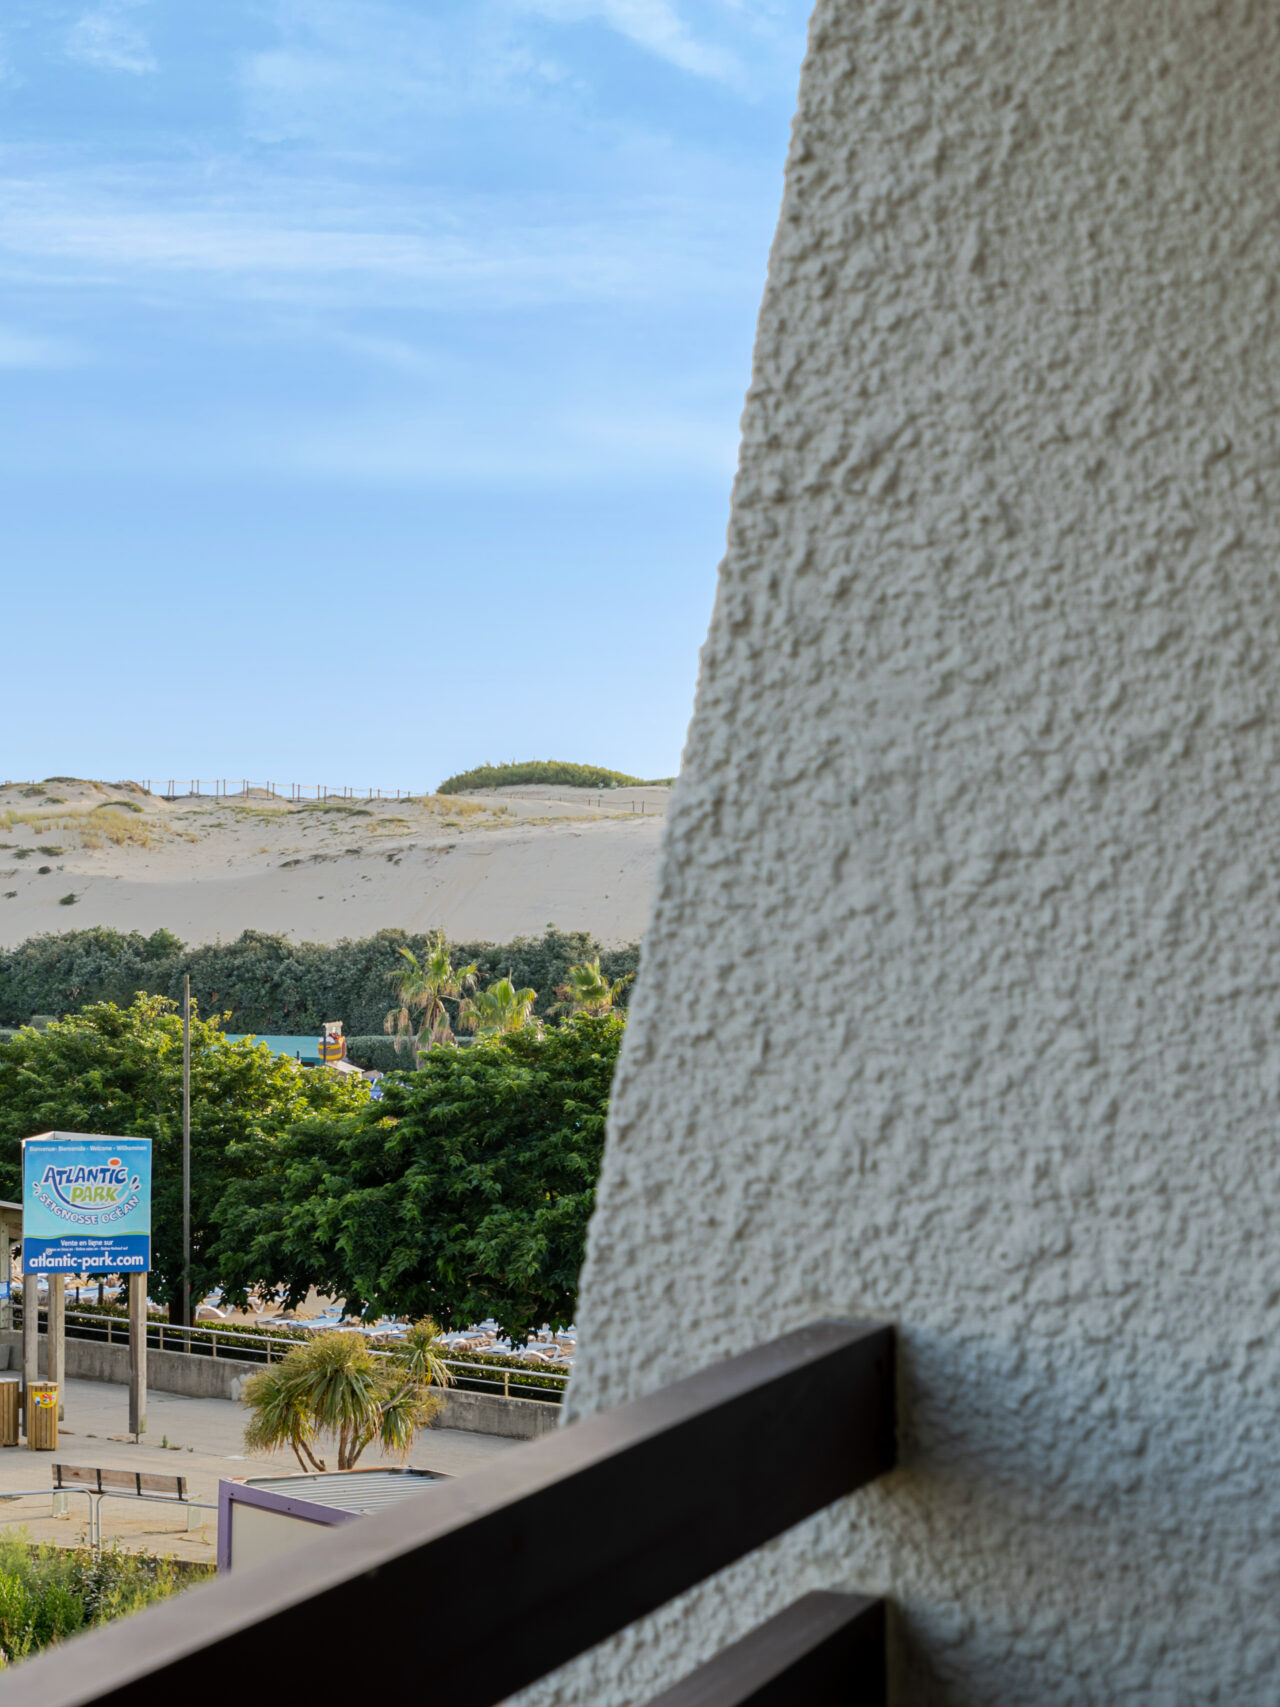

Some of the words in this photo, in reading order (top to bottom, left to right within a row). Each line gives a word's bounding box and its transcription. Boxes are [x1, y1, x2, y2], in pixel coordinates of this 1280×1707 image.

[42, 1165, 128, 1186] ATLANTIC
[70, 1186, 119, 1203] PARK
[39, 1193, 99, 1225] SEIGNOSSE
[101, 1195, 140, 1224] OCÉAN
[61, 1239, 78, 1247] Vente
[87, 1239, 102, 1247] ligne
[29, 1251, 144, 1270] atlantic-park.com
